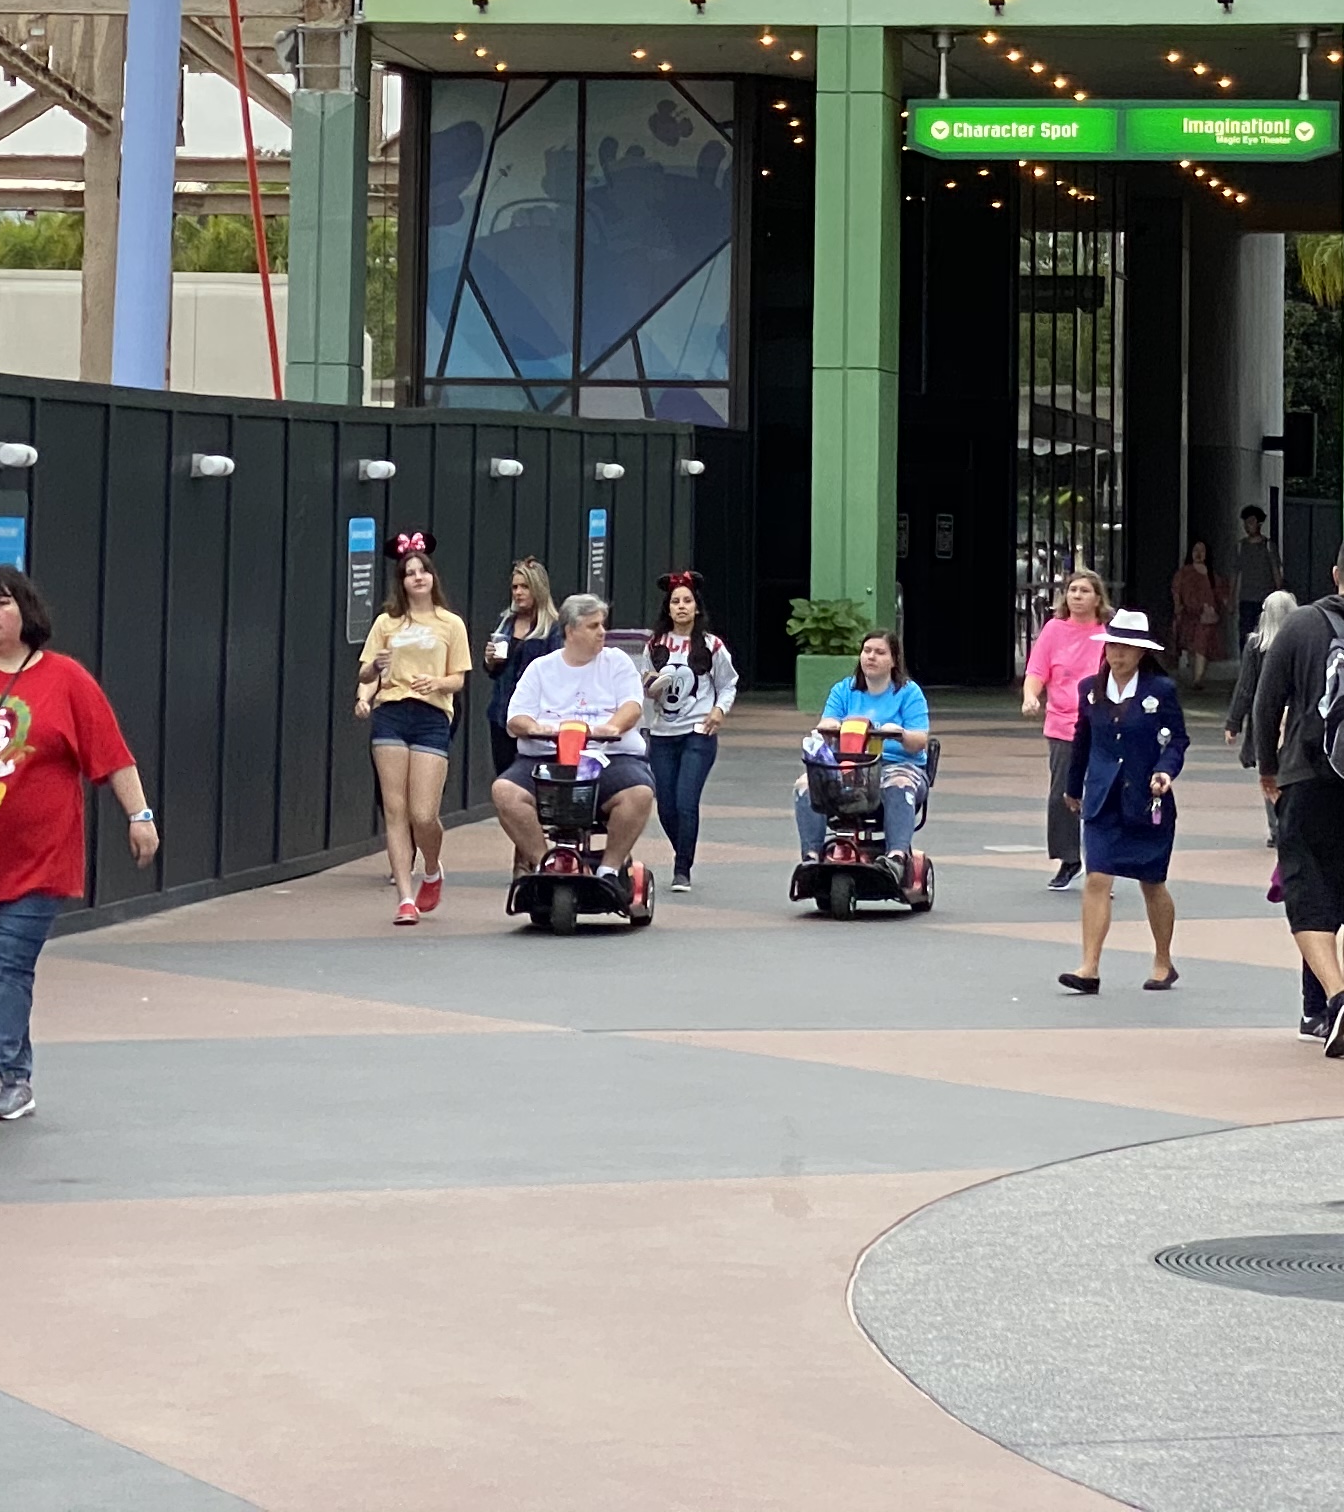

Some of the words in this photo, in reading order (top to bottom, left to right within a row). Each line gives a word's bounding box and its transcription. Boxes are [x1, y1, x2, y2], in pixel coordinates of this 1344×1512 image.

[952, 121, 1036, 138] Character
[1039, 121, 1080, 141] Spot
[1182, 117, 1291, 136] Imagination!
[1215, 135, 1241, 145] Magic
[1242, 135, 1259, 145] Eye
[1259, 135, 1292, 144] Theater
